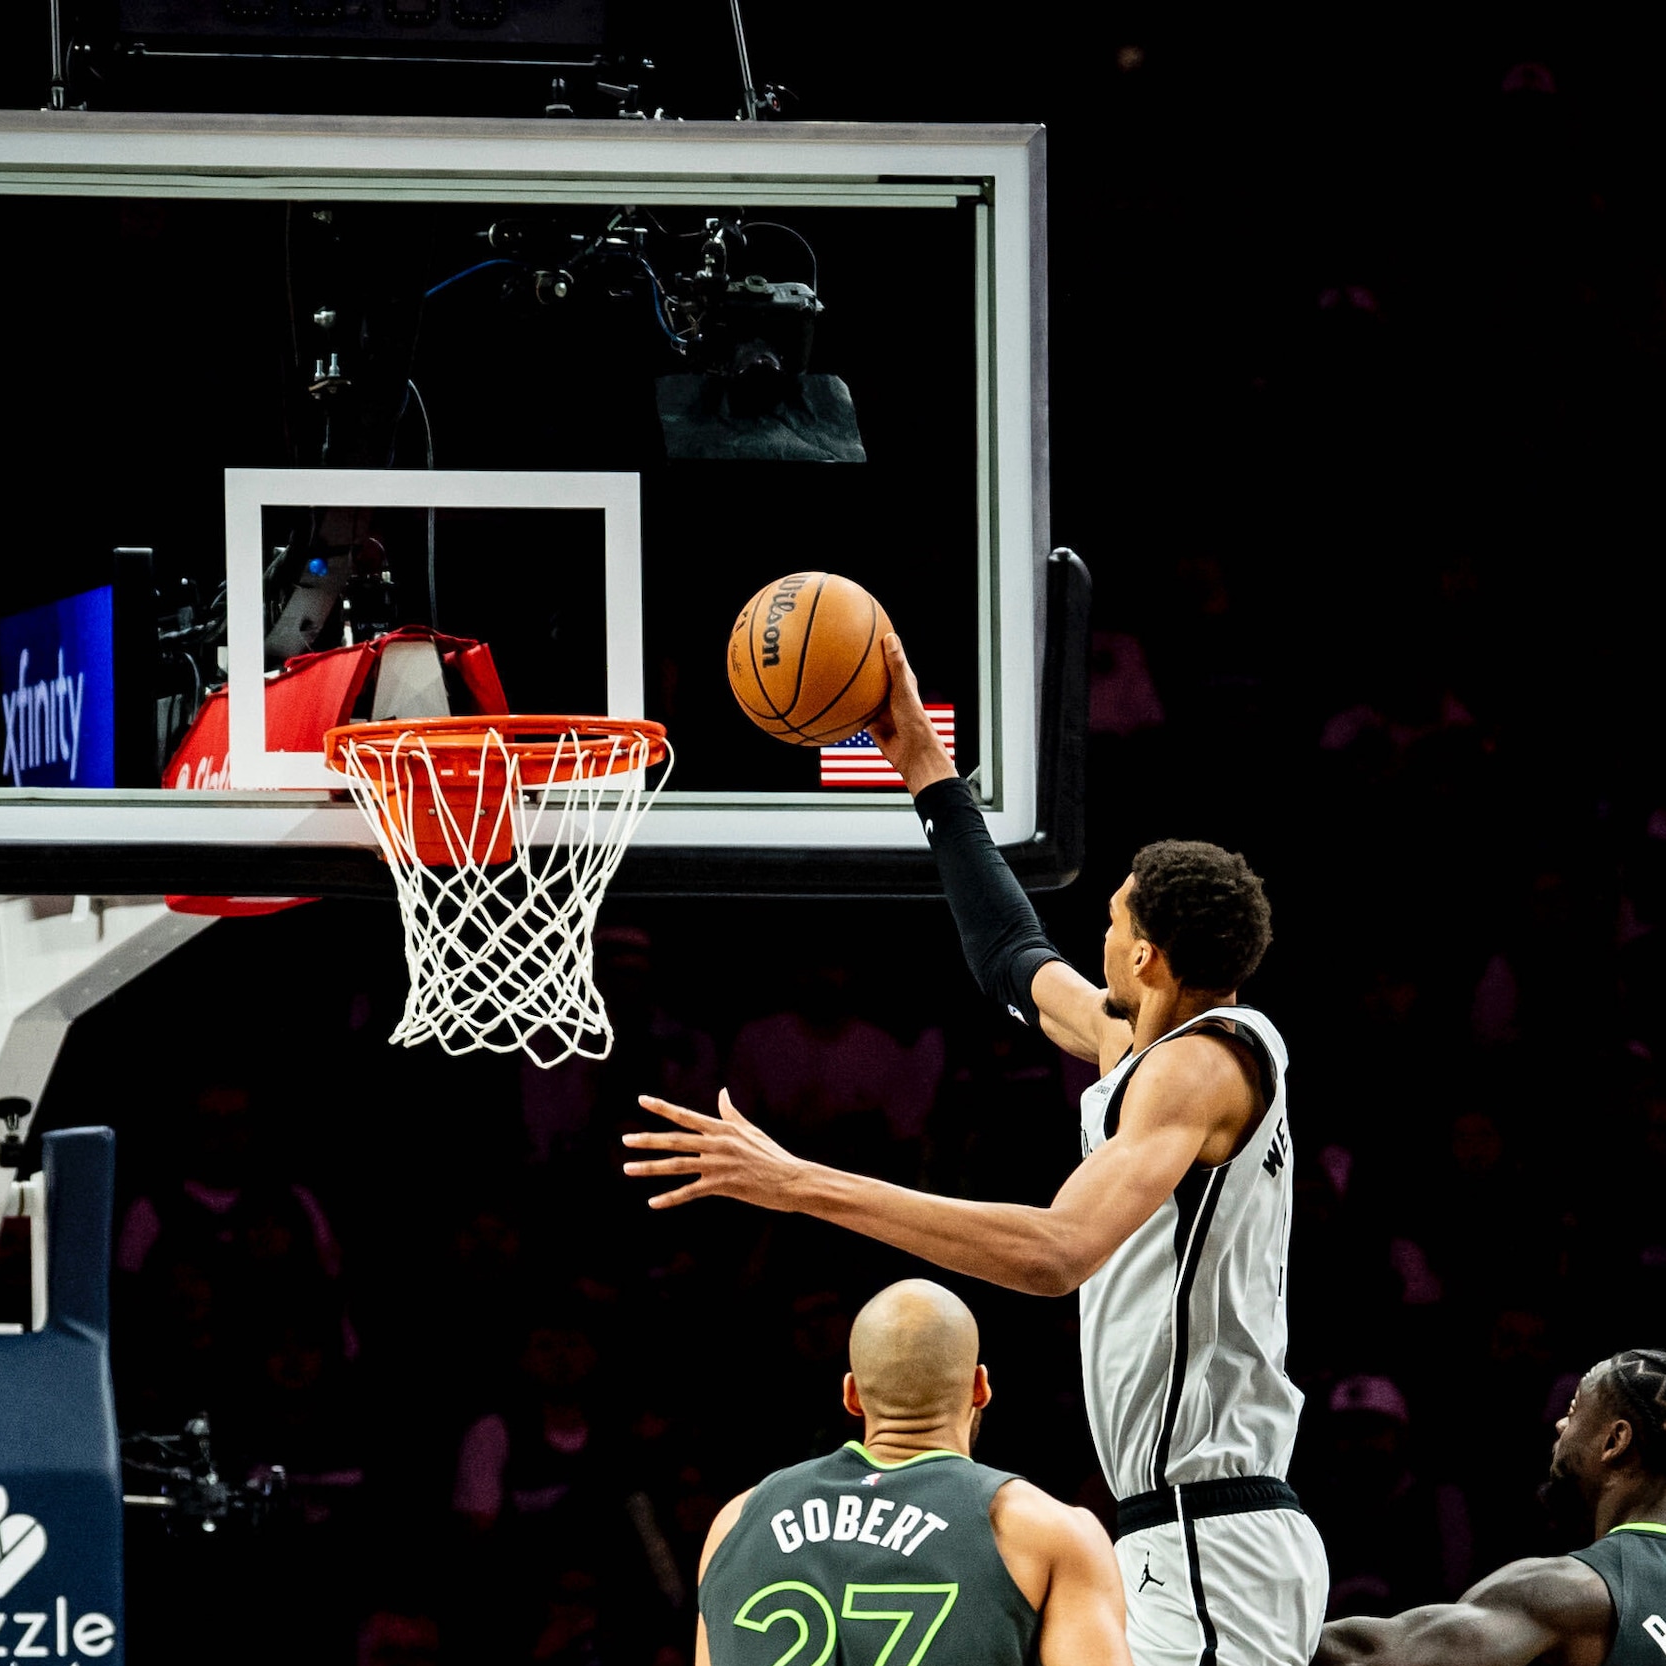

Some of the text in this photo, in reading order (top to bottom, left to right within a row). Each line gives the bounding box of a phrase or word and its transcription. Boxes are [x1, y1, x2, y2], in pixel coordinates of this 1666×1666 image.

[759, 573, 810, 668] Wilson
[2, 646, 84, 786] xfinity
[771, 1494, 949, 1557] GOBERT
